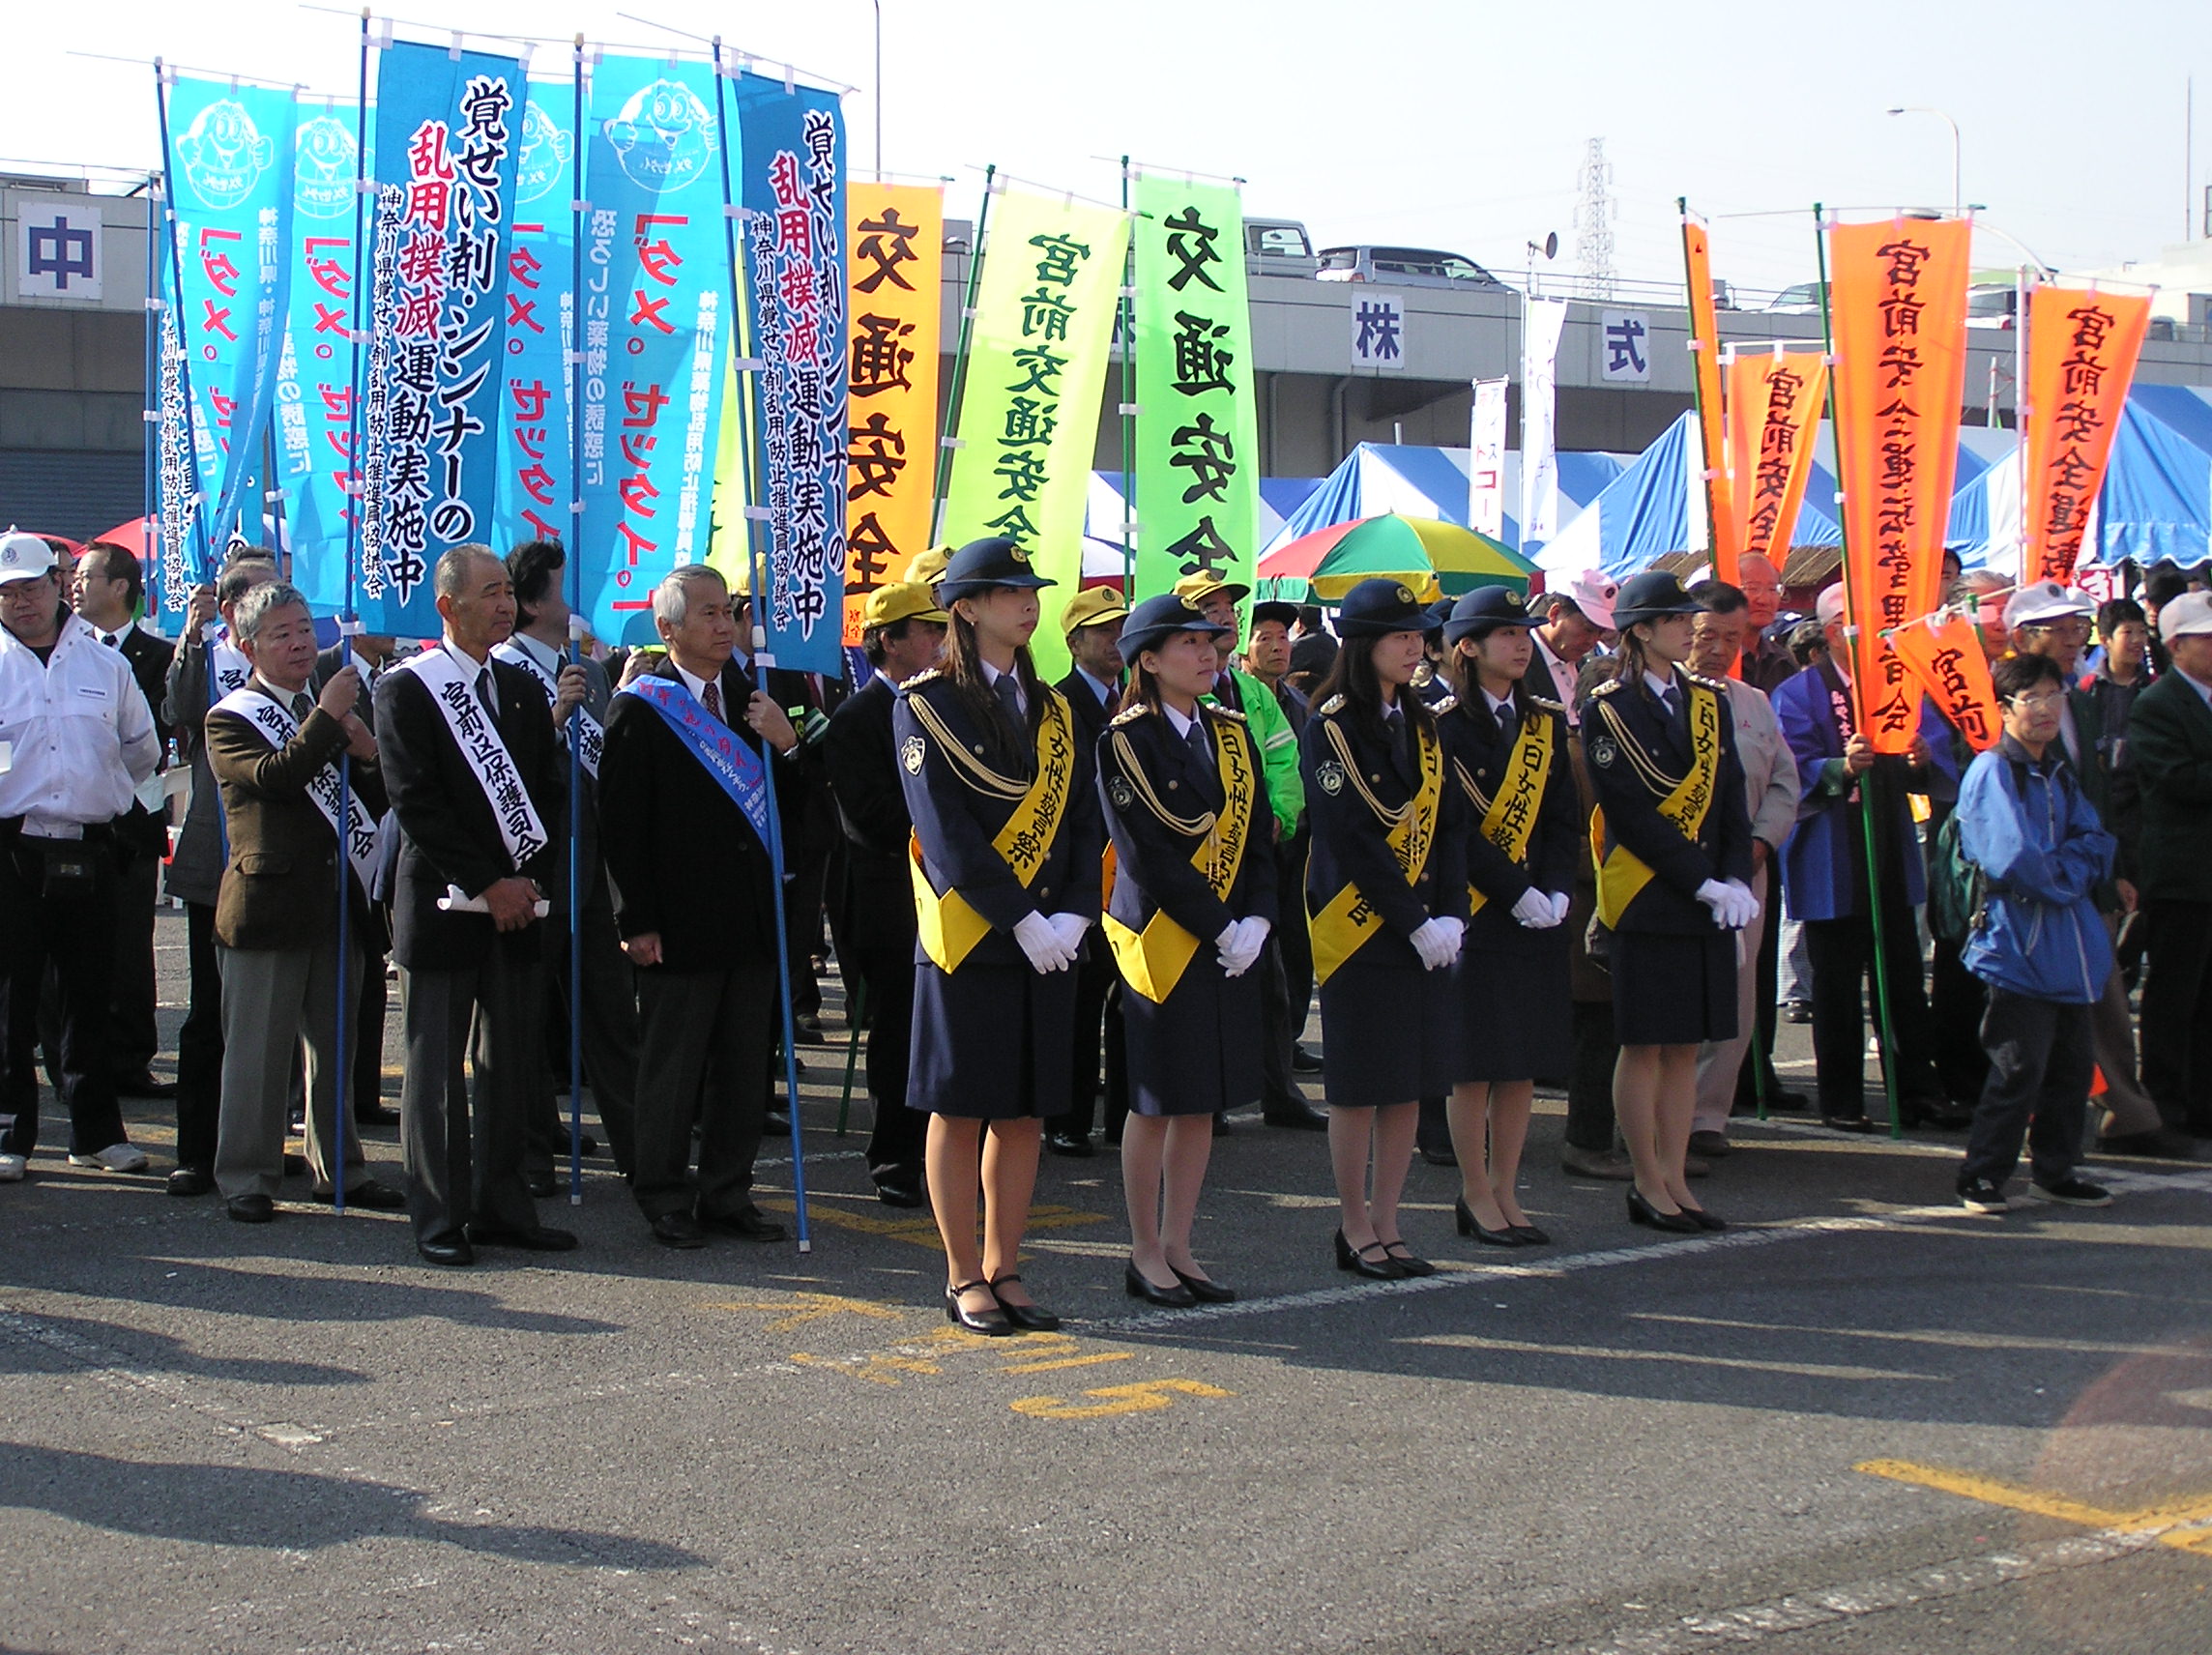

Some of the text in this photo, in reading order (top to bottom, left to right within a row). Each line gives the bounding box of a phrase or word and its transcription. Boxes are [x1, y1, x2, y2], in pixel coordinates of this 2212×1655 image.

[28, 216, 94, 290] 中
[385, 123, 455, 605] 乱用撲滅運動実施中
[1355, 302, 1401, 361] 株
[1607, 319, 1647, 374] 式
[771, 154, 825, 638] 乱用撲滅運動実施中
